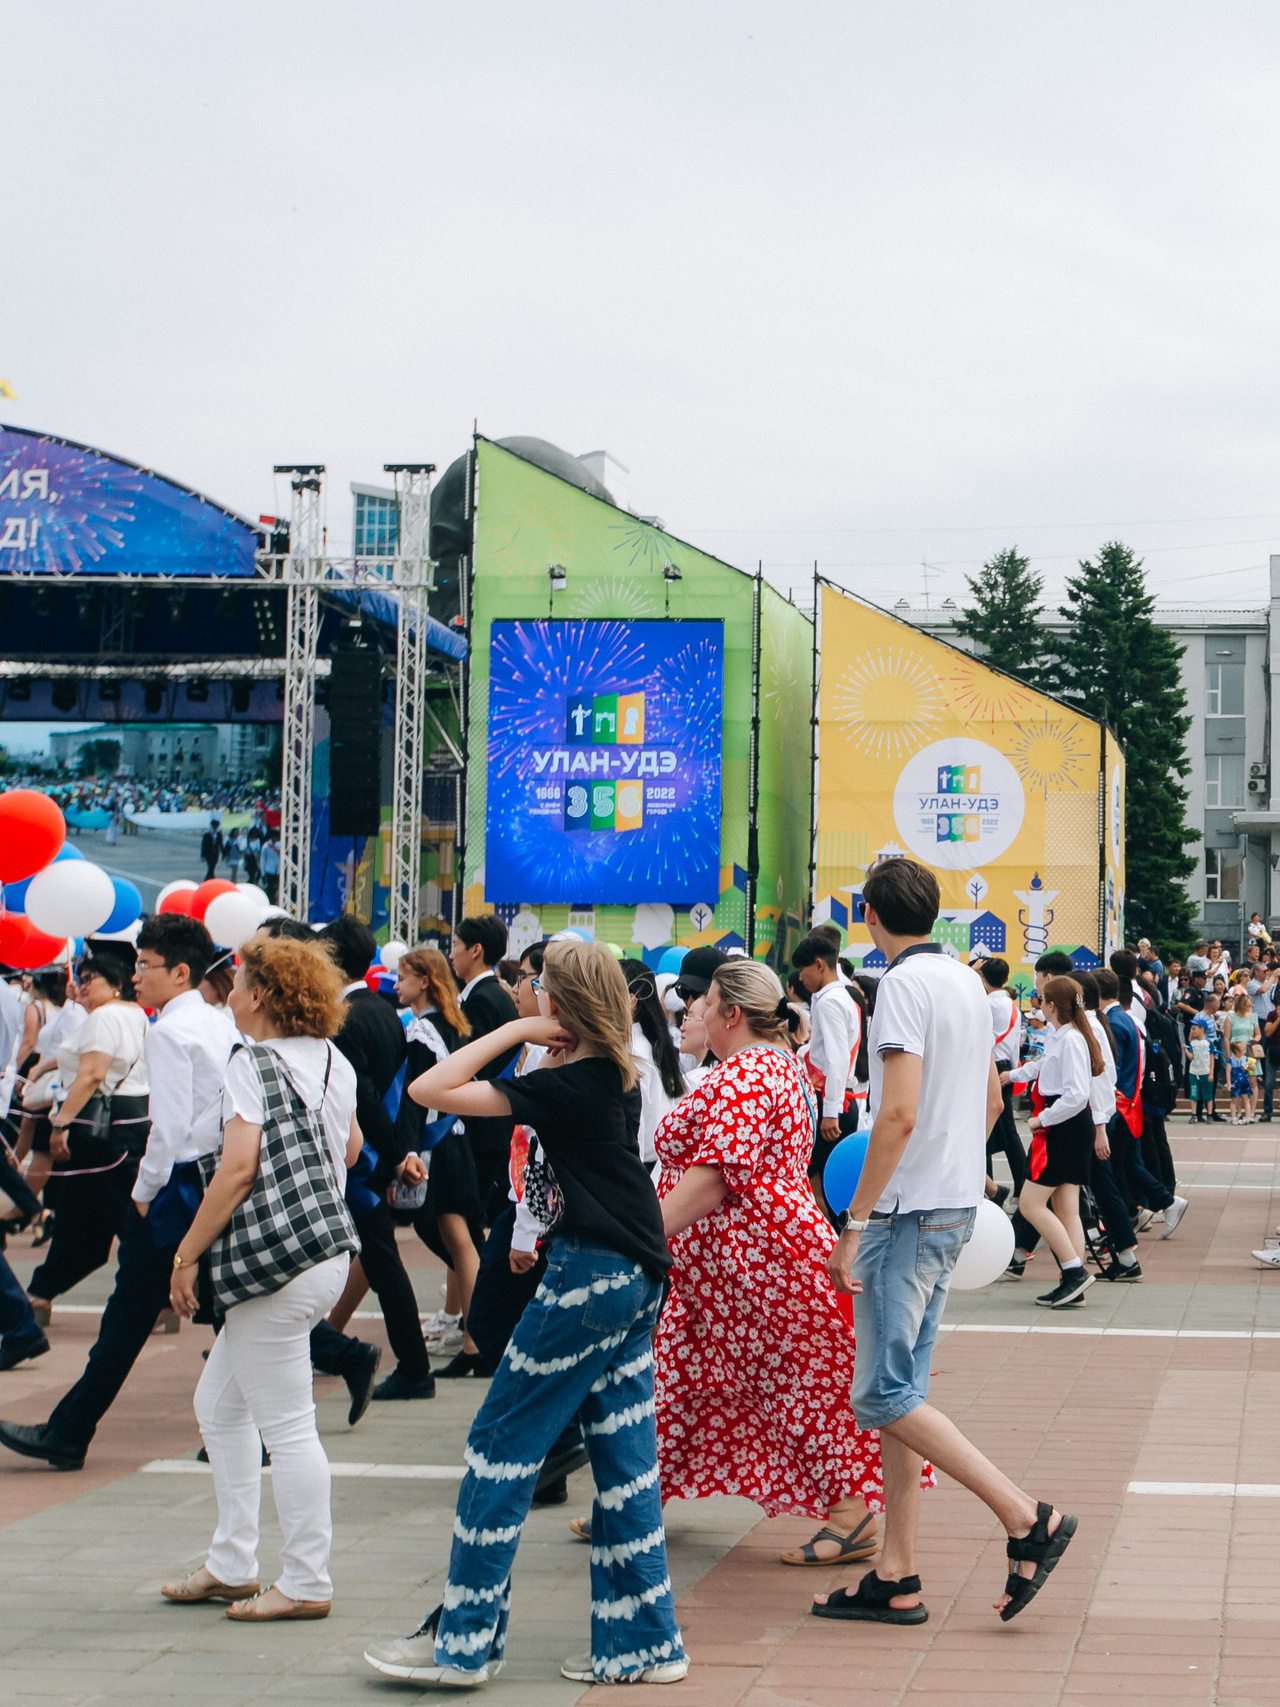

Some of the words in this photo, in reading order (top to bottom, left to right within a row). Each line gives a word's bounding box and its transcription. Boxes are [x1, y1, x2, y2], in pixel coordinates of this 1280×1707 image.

[532, 751, 678, 777] УЛАН-УДЭ
[567, 785, 641, 818] 356
[646, 787, 676, 799] 2022
[919, 798, 999, 812] УЛАН-УДЭ
